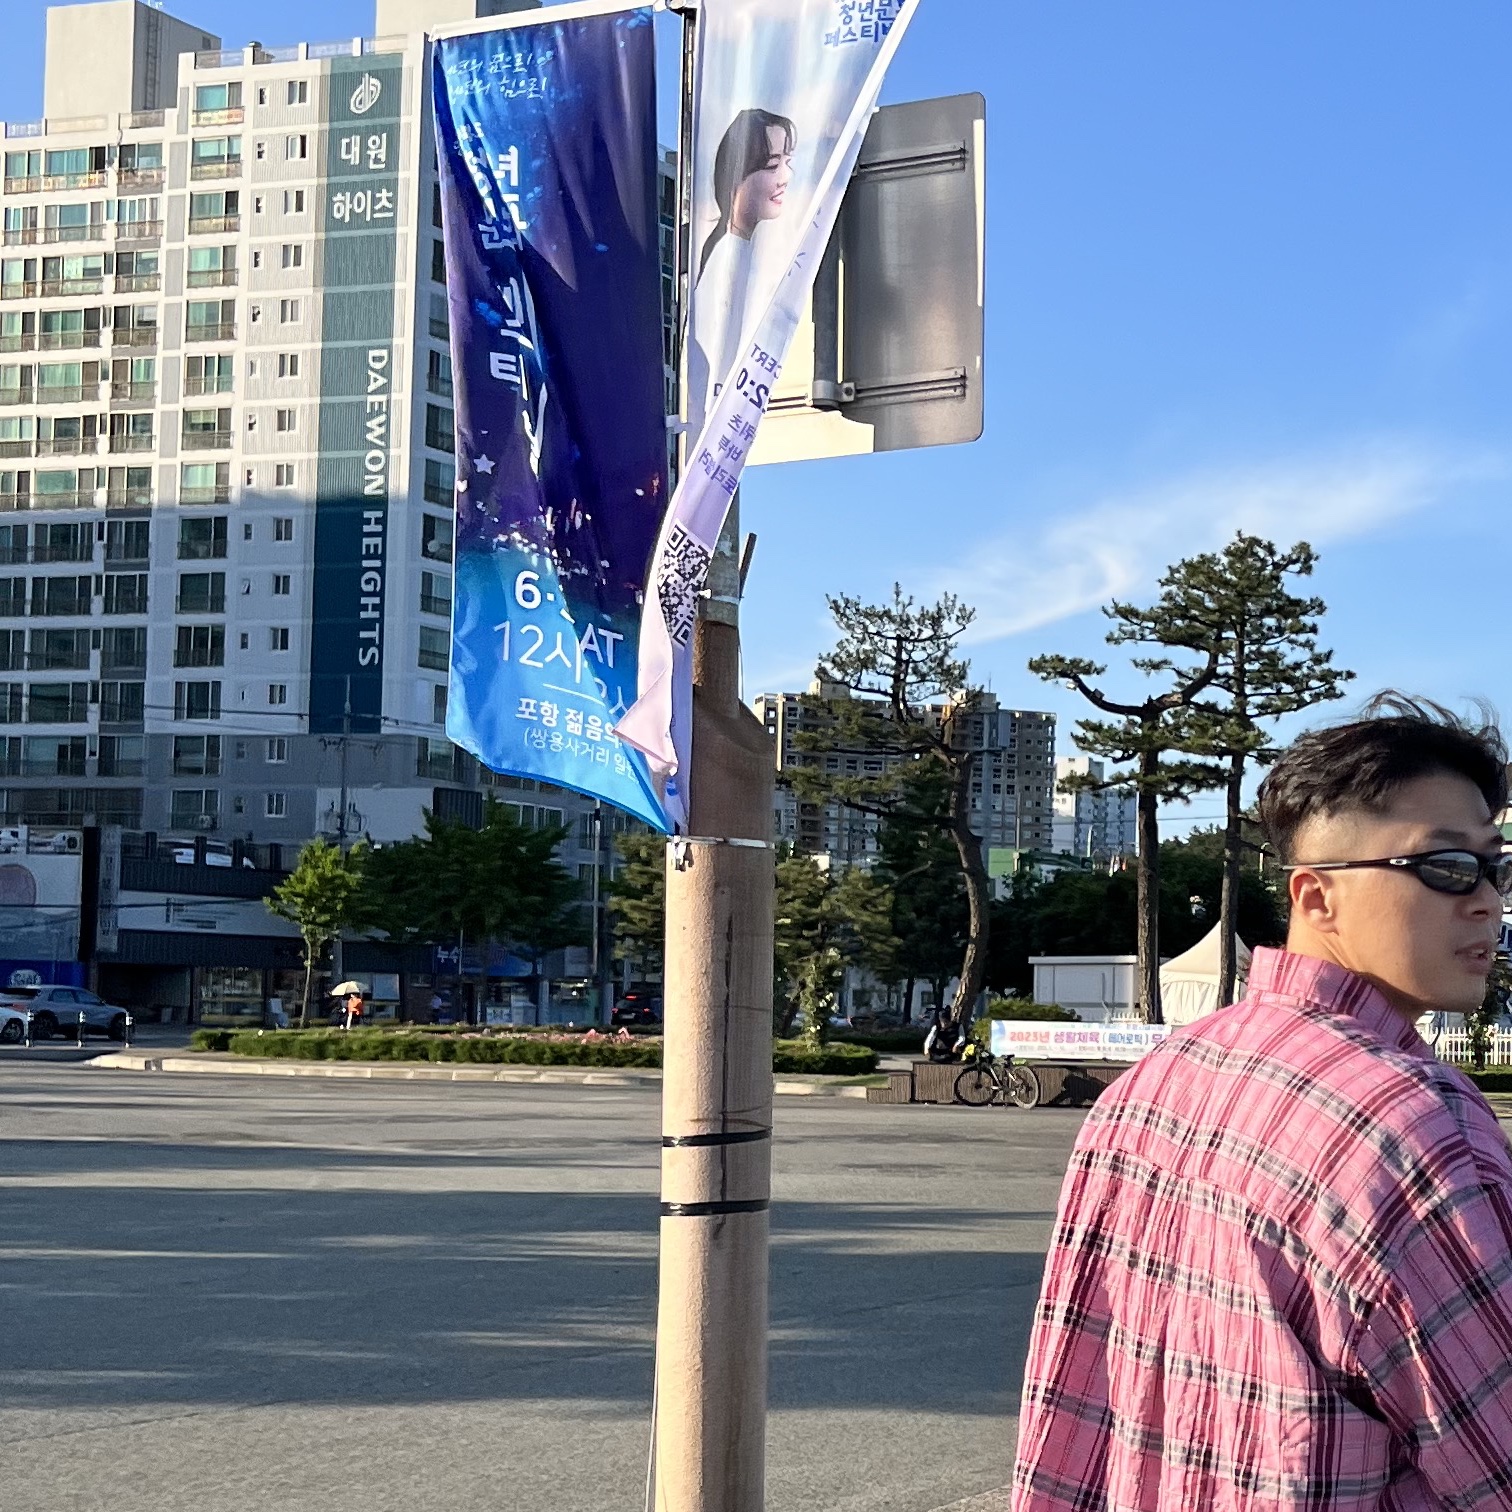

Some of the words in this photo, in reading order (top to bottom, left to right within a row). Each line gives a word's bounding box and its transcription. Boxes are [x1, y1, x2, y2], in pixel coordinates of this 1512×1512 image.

[839, 0, 901, 25] 청년문
[341, 133, 387, 169] 대원
[332, 188, 394, 223] 하이츠
[363, 349, 389, 497] DAEWON
[358, 510, 384, 667] HEIGHTS
[579, 623, 624, 669] AT
[515, 697, 559, 727] 포항
